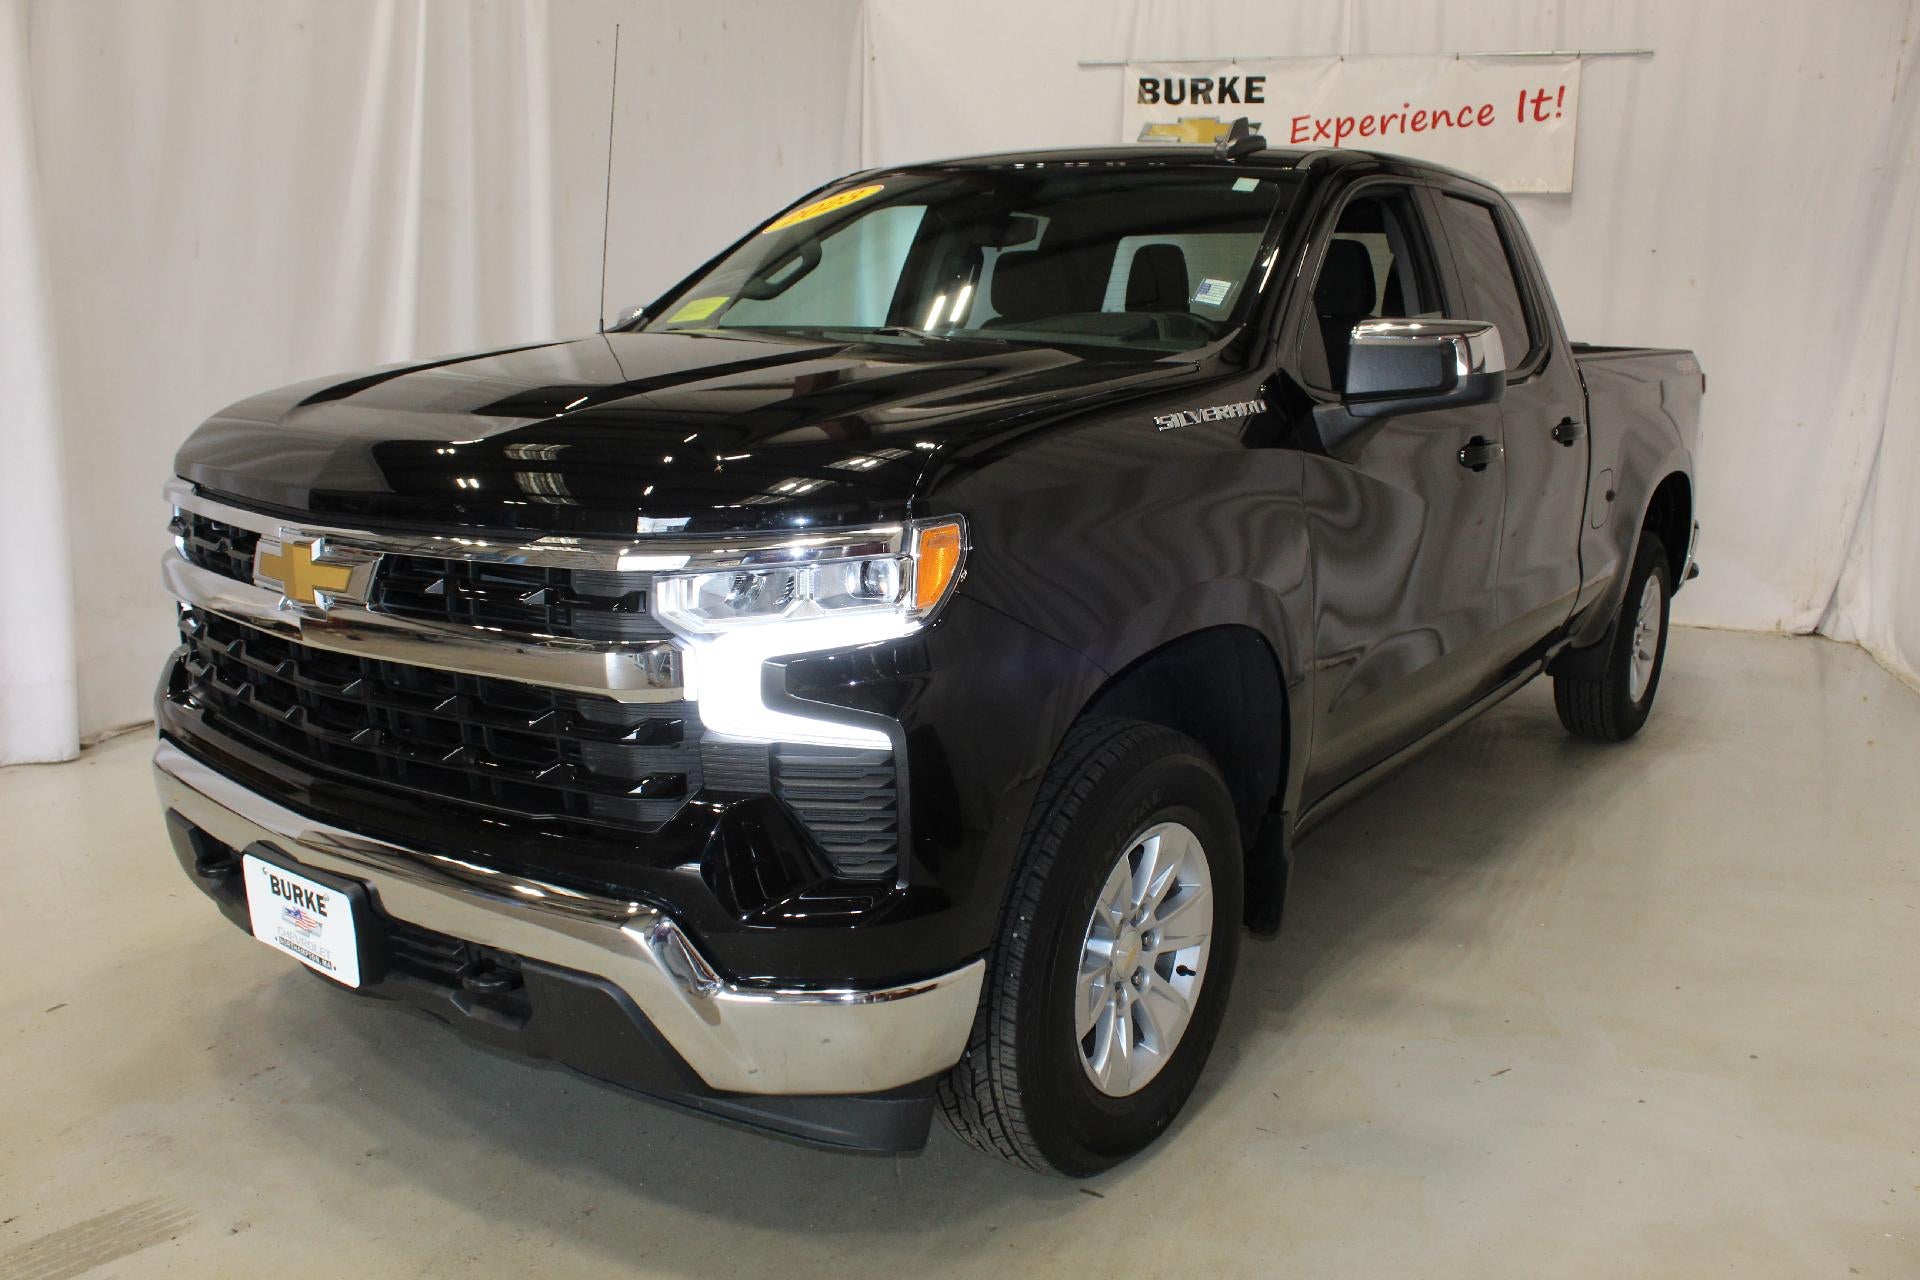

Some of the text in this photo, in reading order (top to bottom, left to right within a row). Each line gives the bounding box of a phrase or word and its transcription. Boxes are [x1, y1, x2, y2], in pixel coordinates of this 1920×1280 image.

[1137, 76, 1266, 105] BURKE
[1290, 85, 1566, 148] Experience It!
[269, 874, 328, 917] BURKE
[277, 926, 331, 960] CHEVROLET
